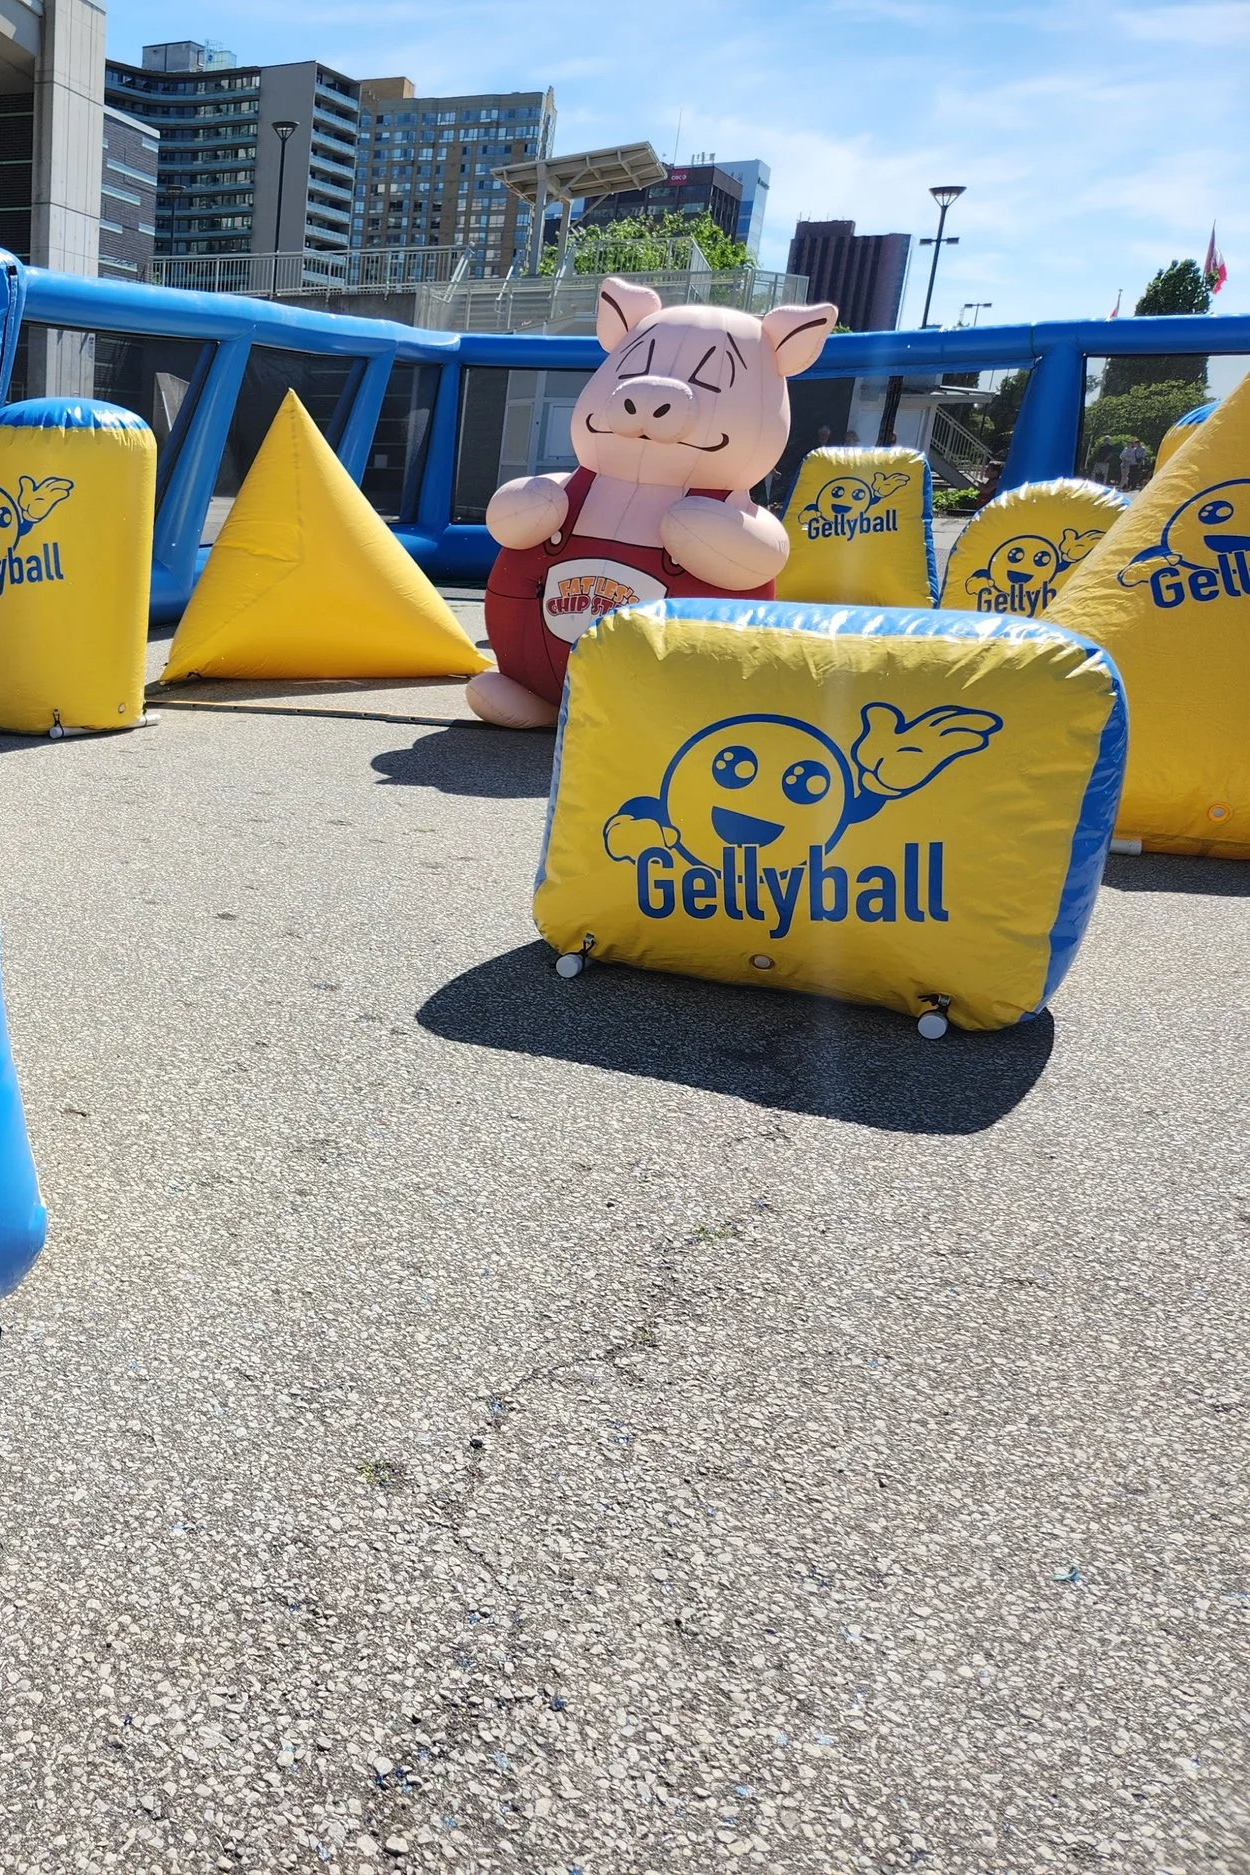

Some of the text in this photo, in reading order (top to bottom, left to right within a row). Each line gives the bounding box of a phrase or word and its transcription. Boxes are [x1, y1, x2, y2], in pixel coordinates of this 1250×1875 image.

[807, 509, 898, 542] Gellyball
[558, 576, 596, 598] FAT
[546, 595, 591, 617] CHIP
[637, 841, 950, 939] Gellyball
